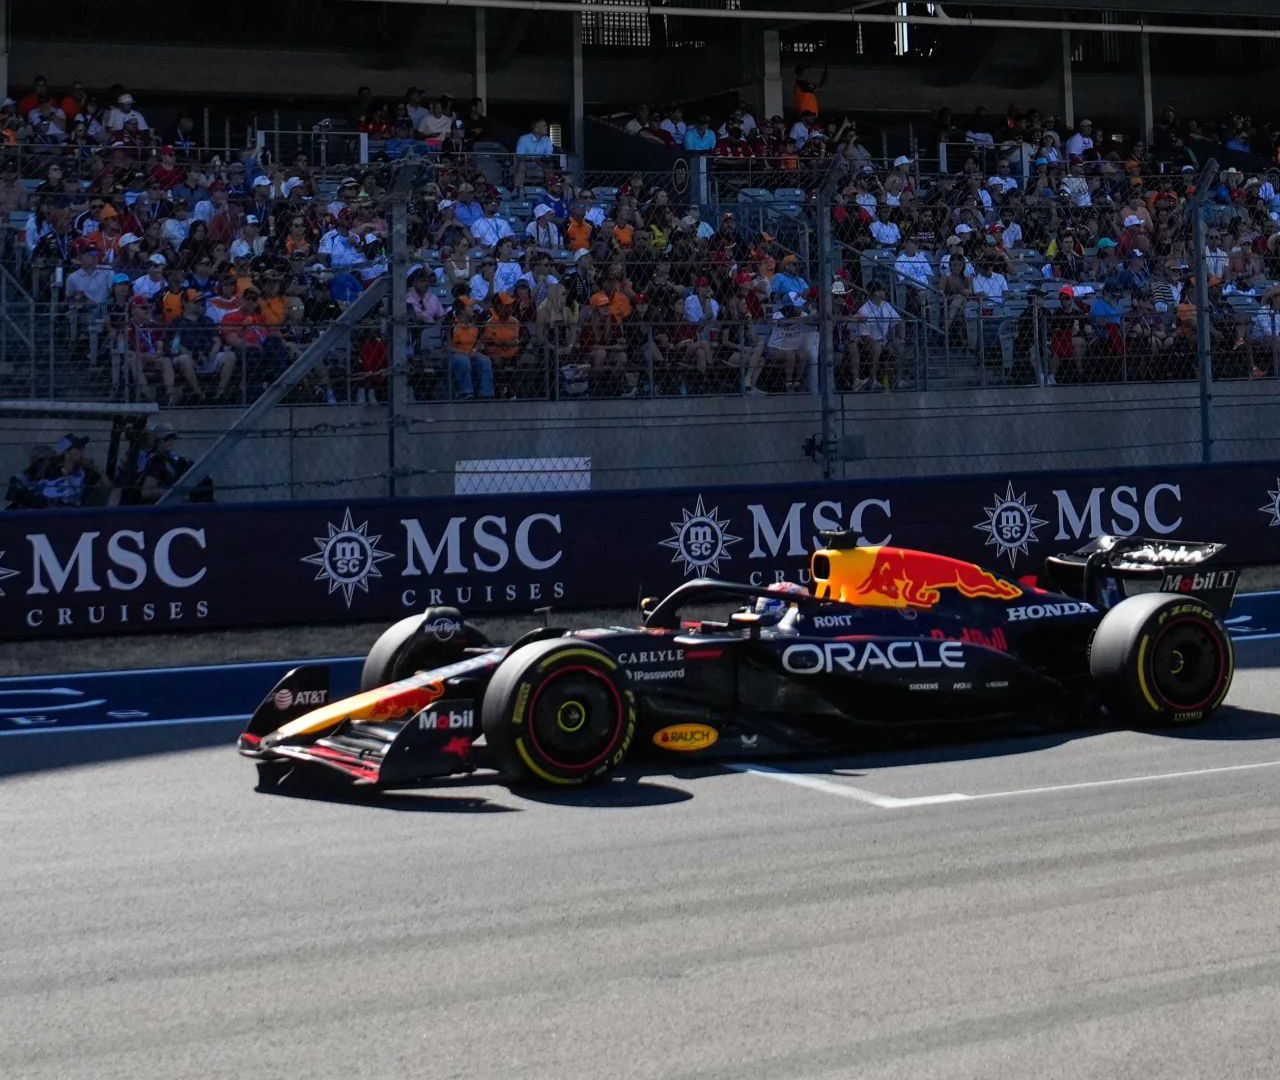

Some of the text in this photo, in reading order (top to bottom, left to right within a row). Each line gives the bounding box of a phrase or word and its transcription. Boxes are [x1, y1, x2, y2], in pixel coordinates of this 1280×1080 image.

[1052, 483, 1183, 540] MSC
[401, 513, 562, 575] MSC
[26, 527, 206, 594] MSC
[1162, 572, 1215, 591] Mobil
[402, 582, 563, 606] CRUISES
[27, 601, 208, 626] CRUISES
[1006, 602, 1099, 621] HONDA
[1170, 604, 1215, 620] ZERO
[813, 615, 852, 628] ROKT
[617, 649, 685, 664] CARLYLE
[782, 641, 966, 675] ORACLE
[295, 689, 327, 705] AT&T
[419, 710, 474, 730] Mobil
[669, 731, 710, 743] RAUCH
